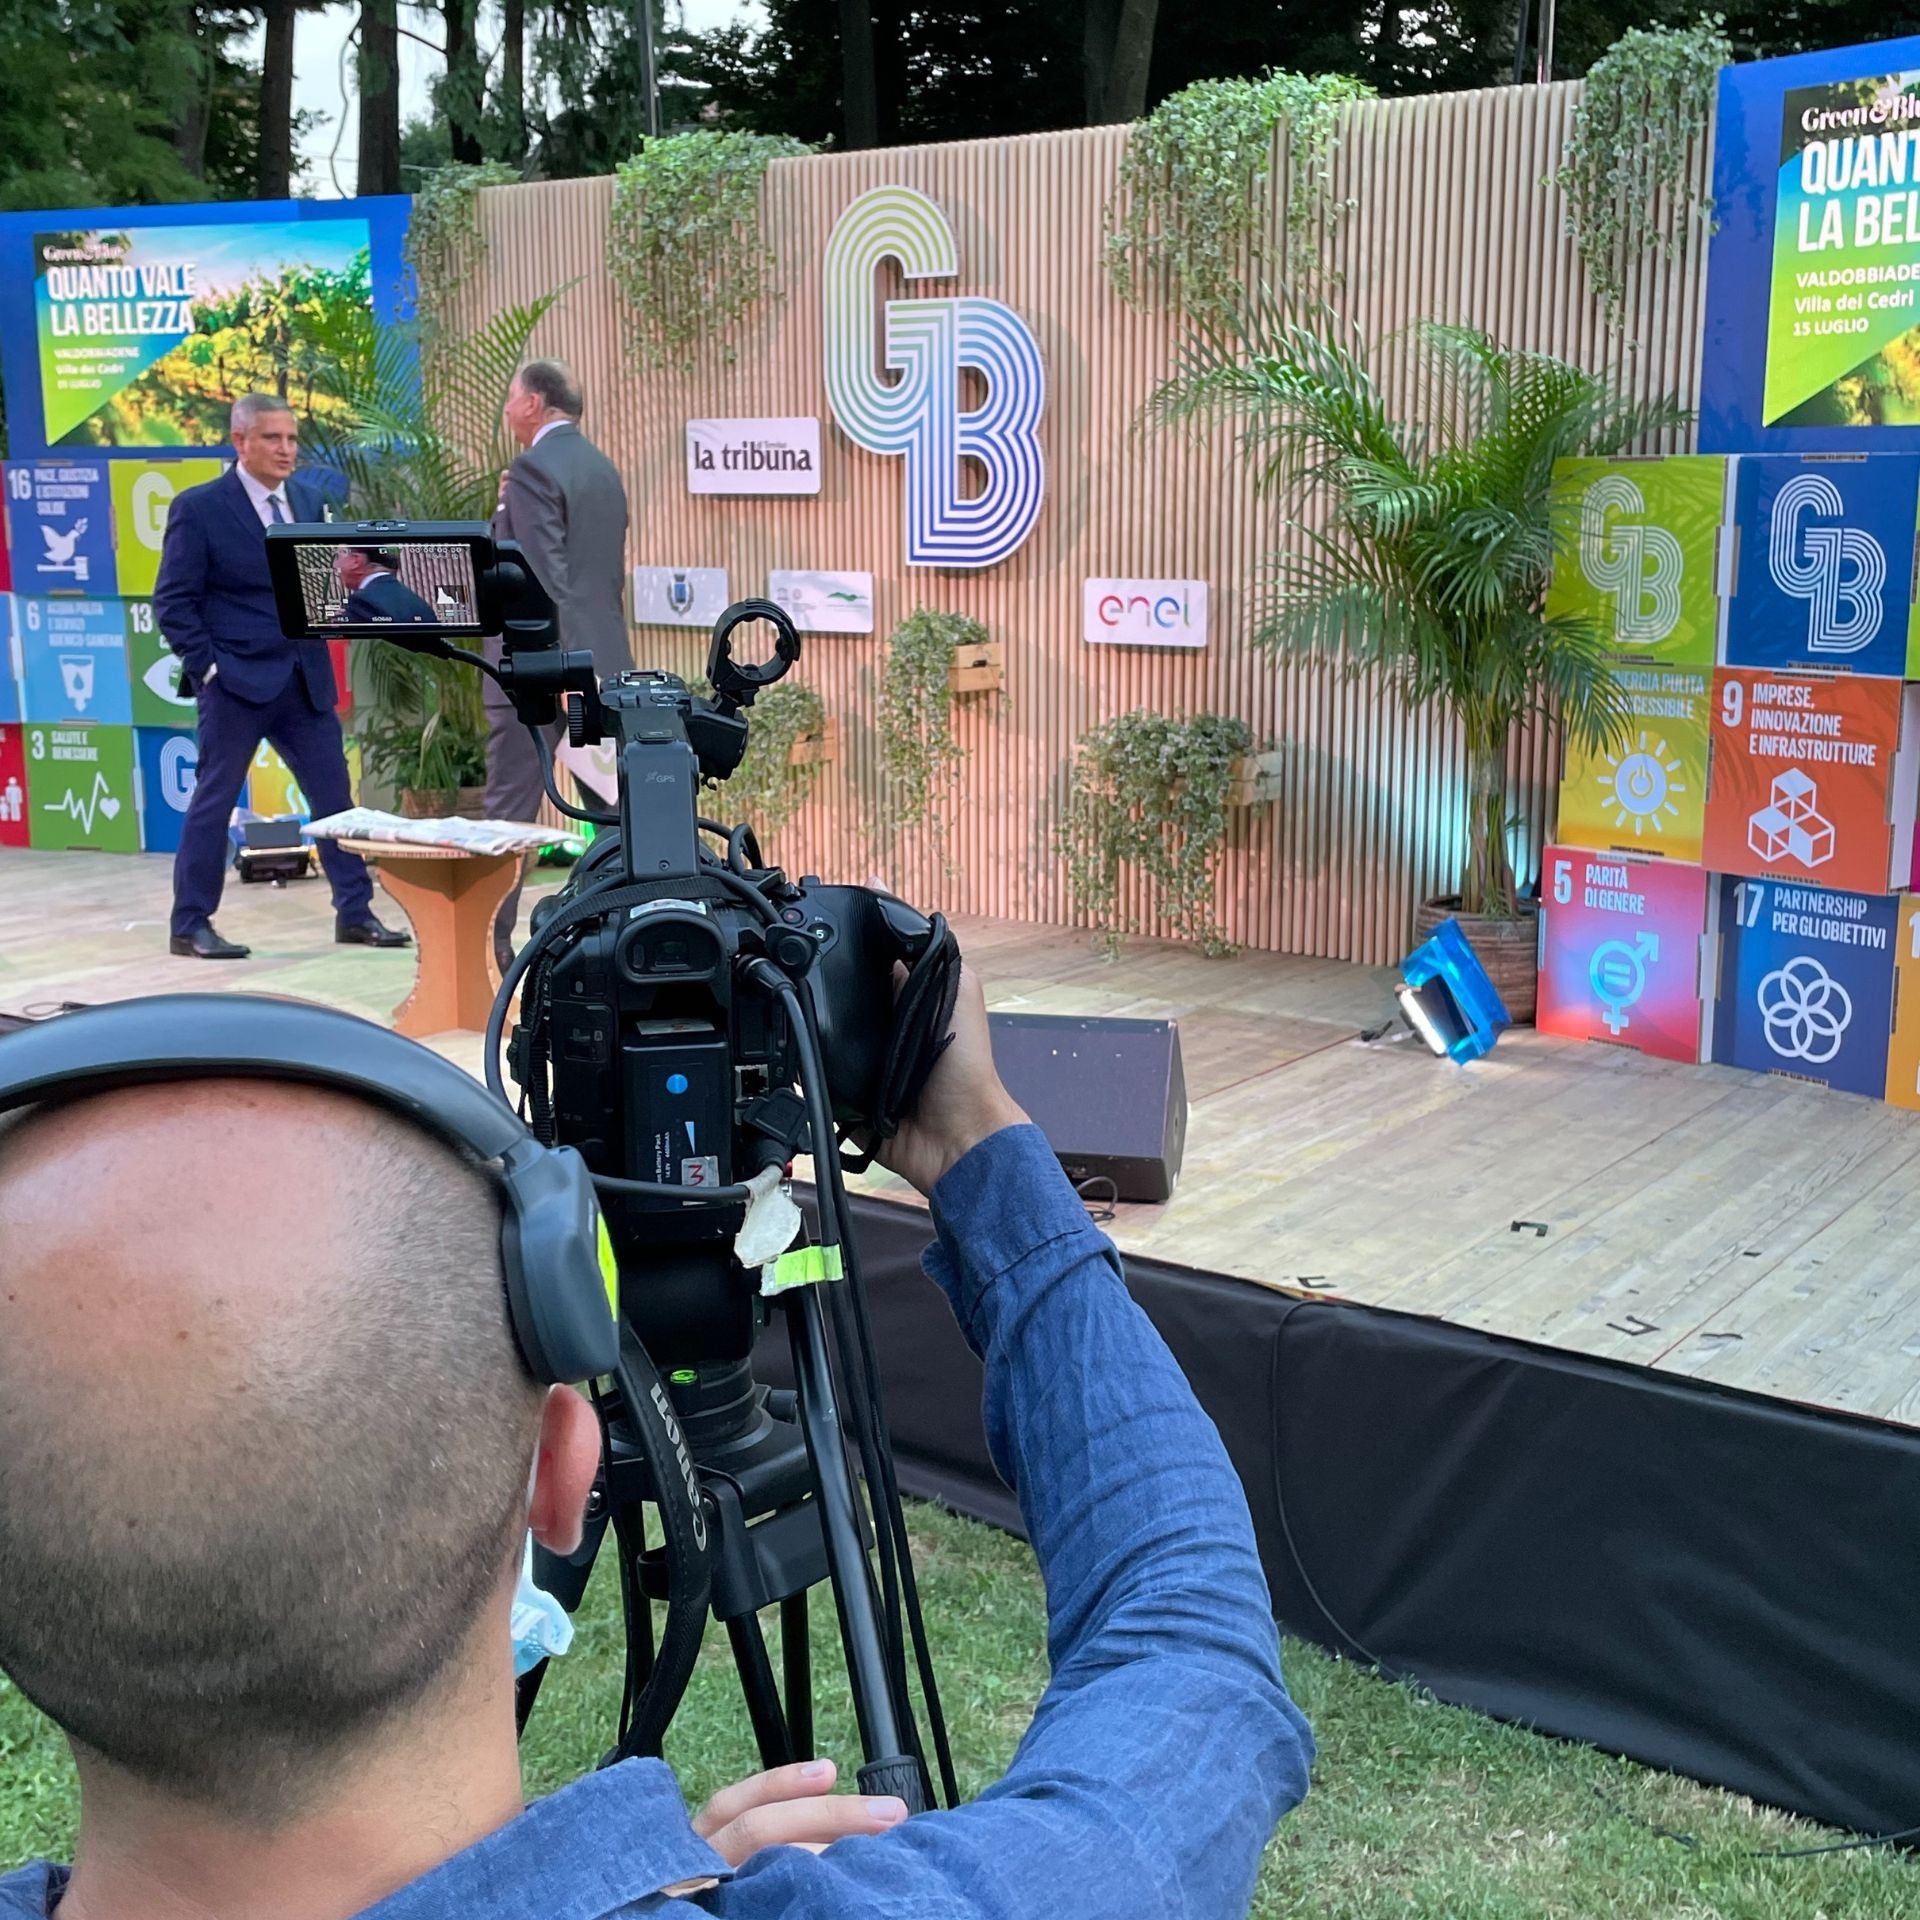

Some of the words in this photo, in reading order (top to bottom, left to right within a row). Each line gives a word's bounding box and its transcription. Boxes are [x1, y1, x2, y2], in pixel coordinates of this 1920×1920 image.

[1798, 199, 1845, 252] LA
[47, 265, 137, 301] QUANTO
[139, 263, 196, 298] VALE
[1795, 263, 1920, 289] VALDOBBIADE
[51, 303, 80, 337] LA
[83, 301, 196, 336] BELLEZZA
[1794, 294, 1831, 314] Villa
[1793, 321, 1811, 337] 15
[1814, 317, 1869, 336] LUGLIO
[694, 441, 716, 471] la
[722, 441, 813, 471] tribuna
[8, 468, 32, 500] 16
[27, 601, 41, 631] 6
[130, 602, 153, 634] 13
[1098, 587, 1191, 631] enel
[1609, 670, 1659, 692] NERGIA
[1662, 672, 1705, 696] PULITA
[1752, 682, 1816, 709] IMPRESE,
[1721, 680, 1744, 727] 9
[1751, 708, 1843, 737] INNOVAZIONE
[31, 729, 45, 760] 3
[1749, 734, 1758, 755] E
[1758, 734, 1878, 767] INFRASTRUTTURE
[656, 775, 676, 783] GPS
[1554, 859, 1572, 905] 5
[1585, 863, 1628, 889] PARITÀ
[1585, 889, 1598, 908] DI
[1599, 891, 1645, 915] GENERE
[1733, 882, 1765, 928] 17
[1773, 887, 1868, 920] PARTNERSHIP
[816, 929, 825, 939] 5
[1772, 911, 1798, 936] PER
[1799, 914, 1821, 939] GLI
[1821, 917, 1886, 950] OBIETTIVI
[654, 1133, 662, 1149] Pack
[650, 1382, 707, 1551] Canon
